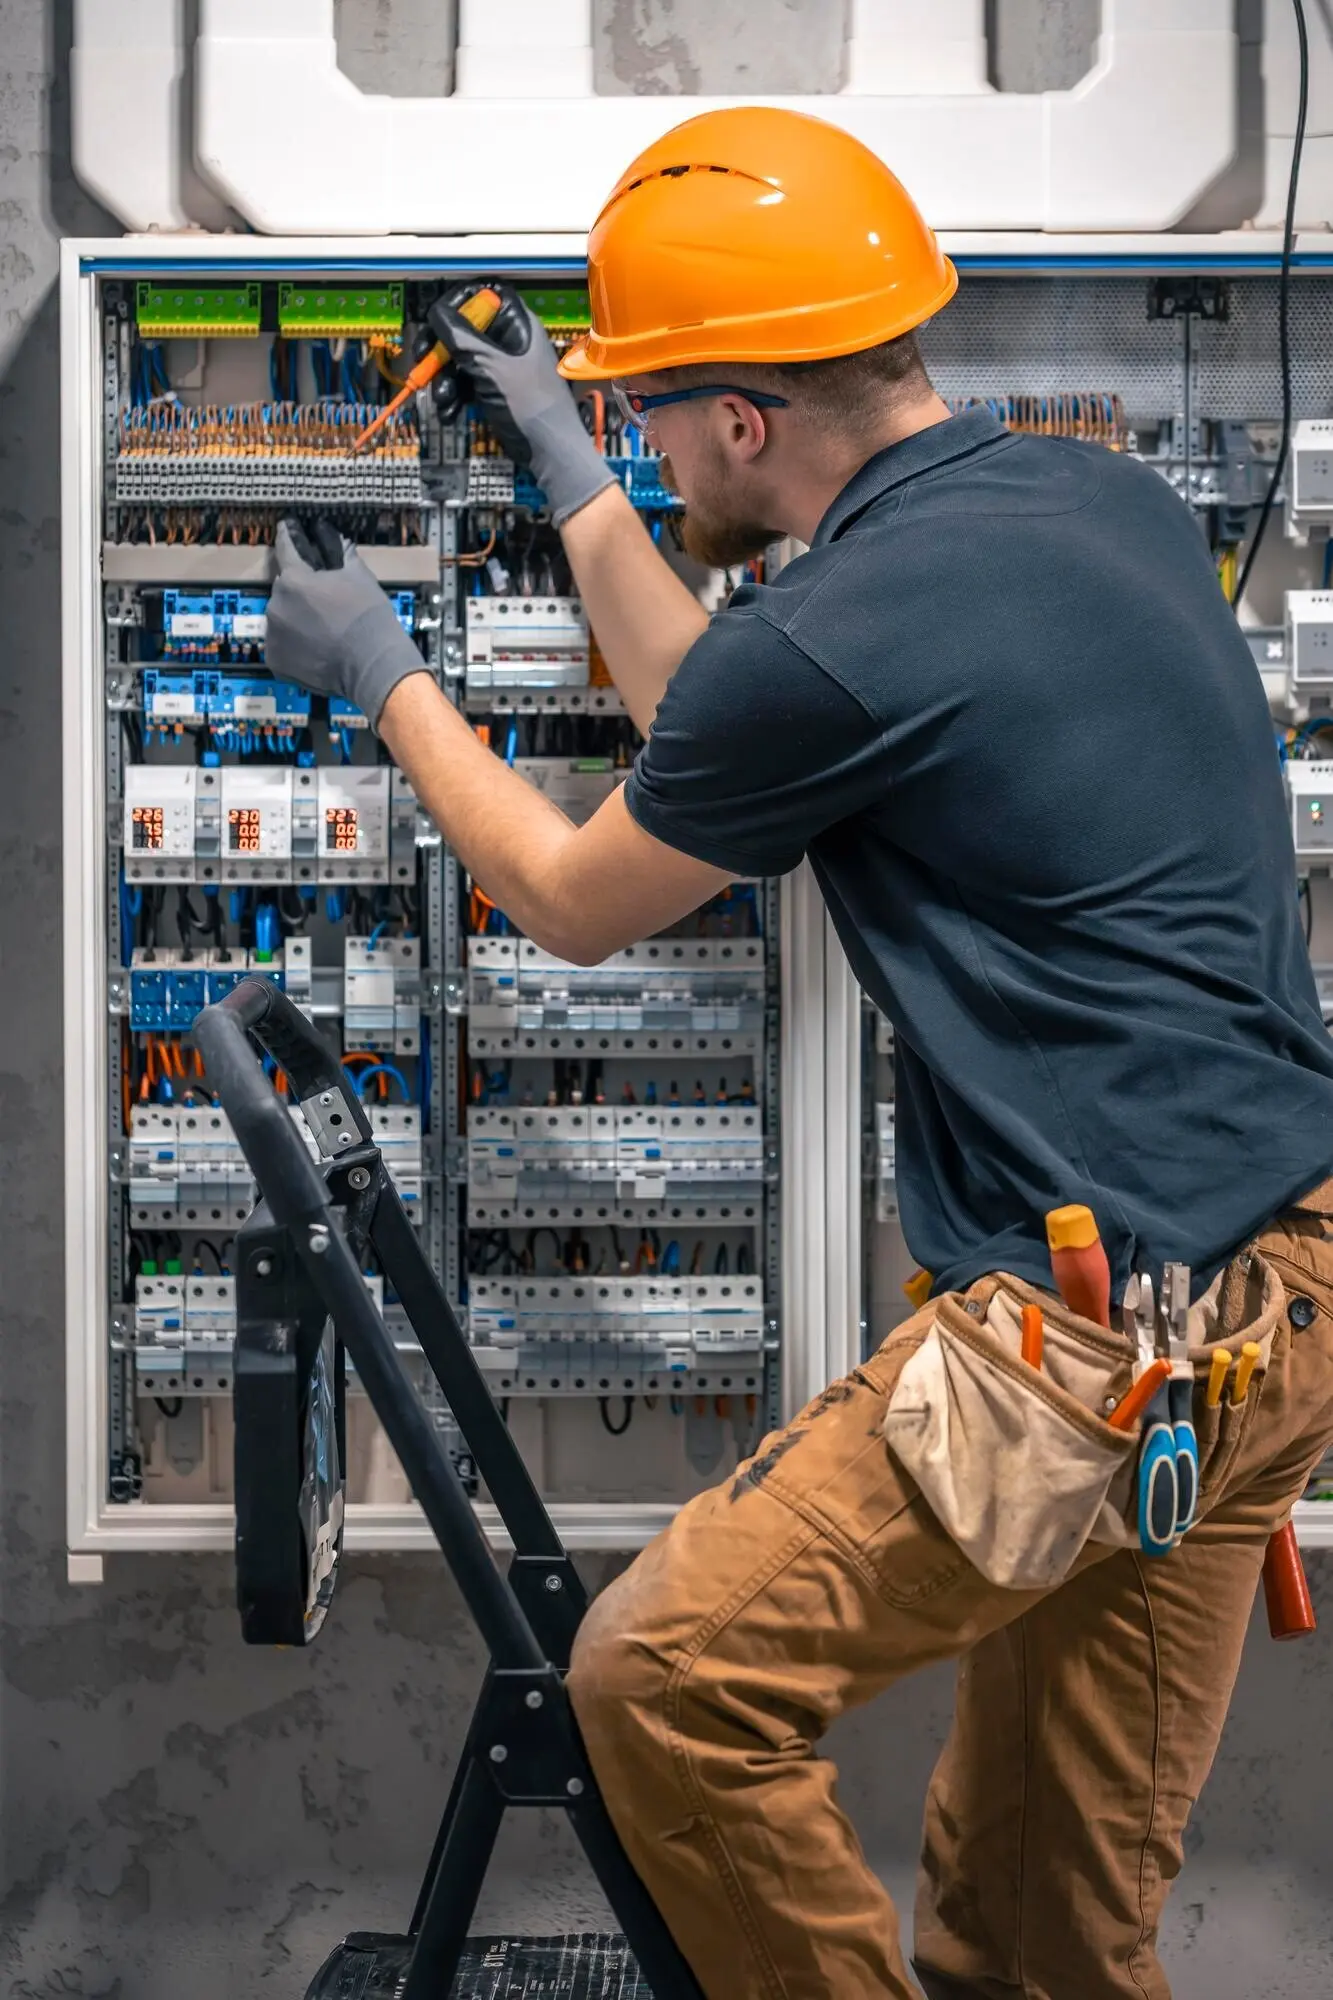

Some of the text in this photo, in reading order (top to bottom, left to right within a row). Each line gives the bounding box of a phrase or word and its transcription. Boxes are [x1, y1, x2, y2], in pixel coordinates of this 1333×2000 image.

[132, 808, 162, 821] 226
[228, 809, 259, 823] 230
[326, 808, 357, 822] 227
